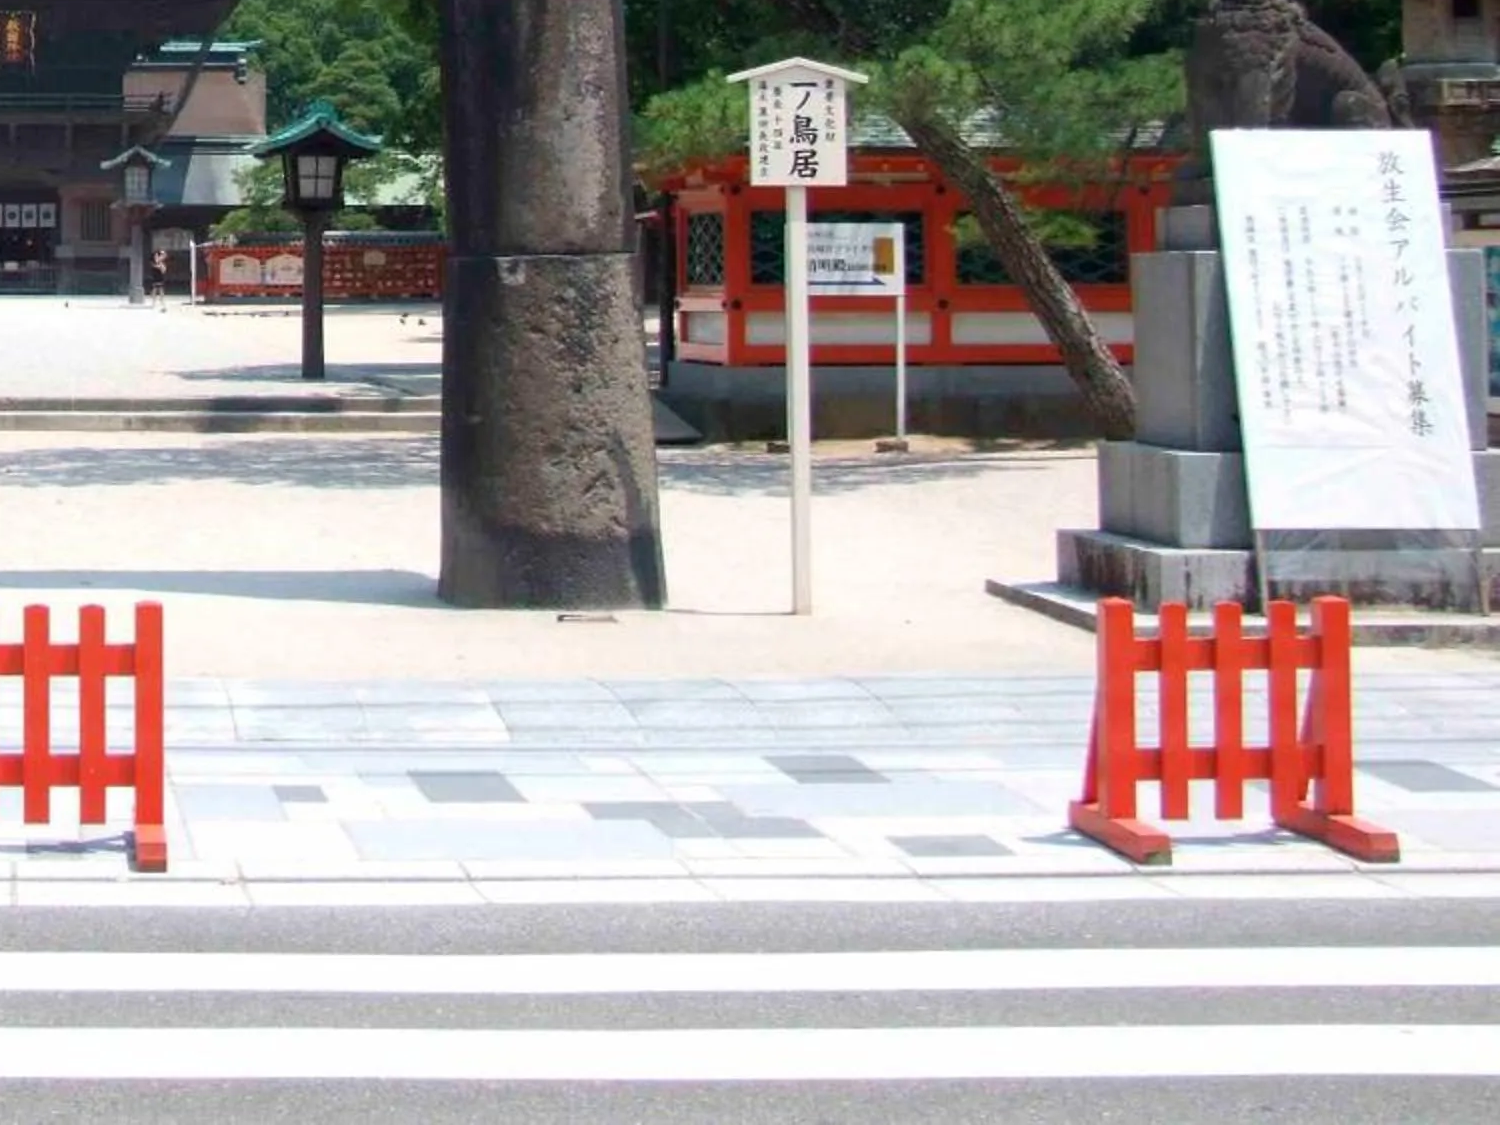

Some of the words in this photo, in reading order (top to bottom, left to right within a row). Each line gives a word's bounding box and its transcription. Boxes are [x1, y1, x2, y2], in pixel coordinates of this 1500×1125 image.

[789, 81, 819, 178] 一ノ鳥居
[1378, 150, 1433, 437] 放生会アルバイト募集
